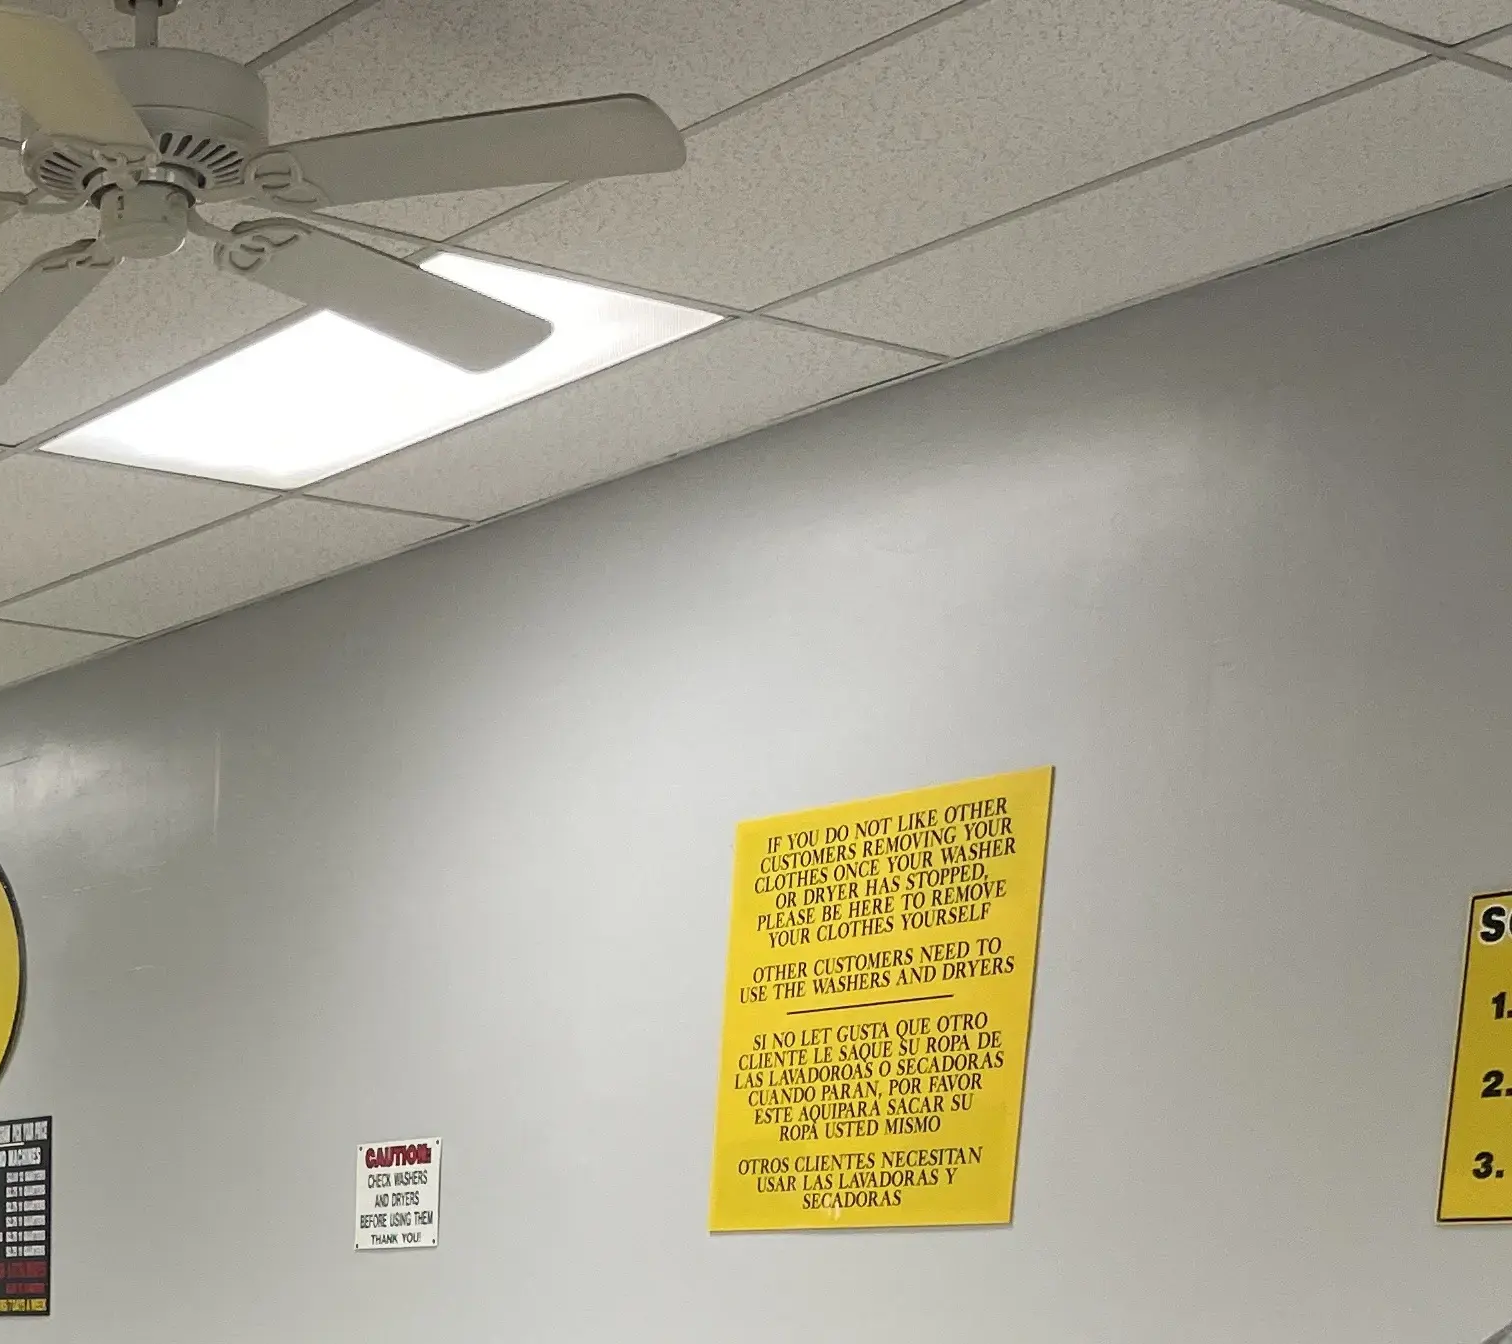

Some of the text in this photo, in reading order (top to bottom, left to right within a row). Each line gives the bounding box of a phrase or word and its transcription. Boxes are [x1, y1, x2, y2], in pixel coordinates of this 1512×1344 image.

[767, 797, 1007, 853] IF YOU DO NOT LIKE OTHER
[760, 816, 1012, 873] CUSTOMERS REMOVING YOUR
[754, 836, 1015, 893] CLOTHES ONCE YOUR WASHER
[775, 862, 988, 909] OR DRYER HAS STOPPED,
[756, 879, 1006, 931] PLEASE BE HERE TO REMOVE
[768, 901, 991, 948] YOUR CLOTHES YOURSELF
[1479, 905, 1512, 943] S
[752, 936, 1001, 983] OTHER CUSTOMERS NEED TO
[740, 955, 1014, 1003] USE THE WASHERS AND DRYERS
[752, 1033, 766, 1050] SI
[772, 1031, 795, 1048] NO
[836, 1021, 889, 1042] GUSTA
[895, 1017, 930, 1040] QUE
[936, 1011, 987, 1033] OTRO
[738, 1030, 1001, 1070] CLIENTE LE SAQUE SU ROPA DE
[734, 1050, 1003, 1089] LAS LAVADOROAS O SECADORAS
[1481, 1070, 1512, 1098] 2.
[748, 1085, 815, 1106] CUANDO
[888, 1077, 921, 1096] POR
[929, 1072, 982, 1092] FAVOR
[754, 1106, 792, 1124] ESTE
[886, 1095, 944, 1115] SACAR
[950, 1093, 973, 1111] SU
[779, 1115, 940, 1141] ROPA USTED MISMO
[738, 1146, 982, 1175] OTROS CLIENTES NECESITAN
[1472, 1151, 1505, 1179] 3.
[368, 1170, 428, 1188] CHECK WASHERS
[757, 1167, 958, 1192] USAR LAS LAVADORAS Y
[375, 1191, 420, 1208] AND DRYERS
[802, 1189, 901, 1209] SECADORAS
[360, 1211, 433, 1229] BEFORE USING THEM
[371, 1234, 398, 1245] THANK
